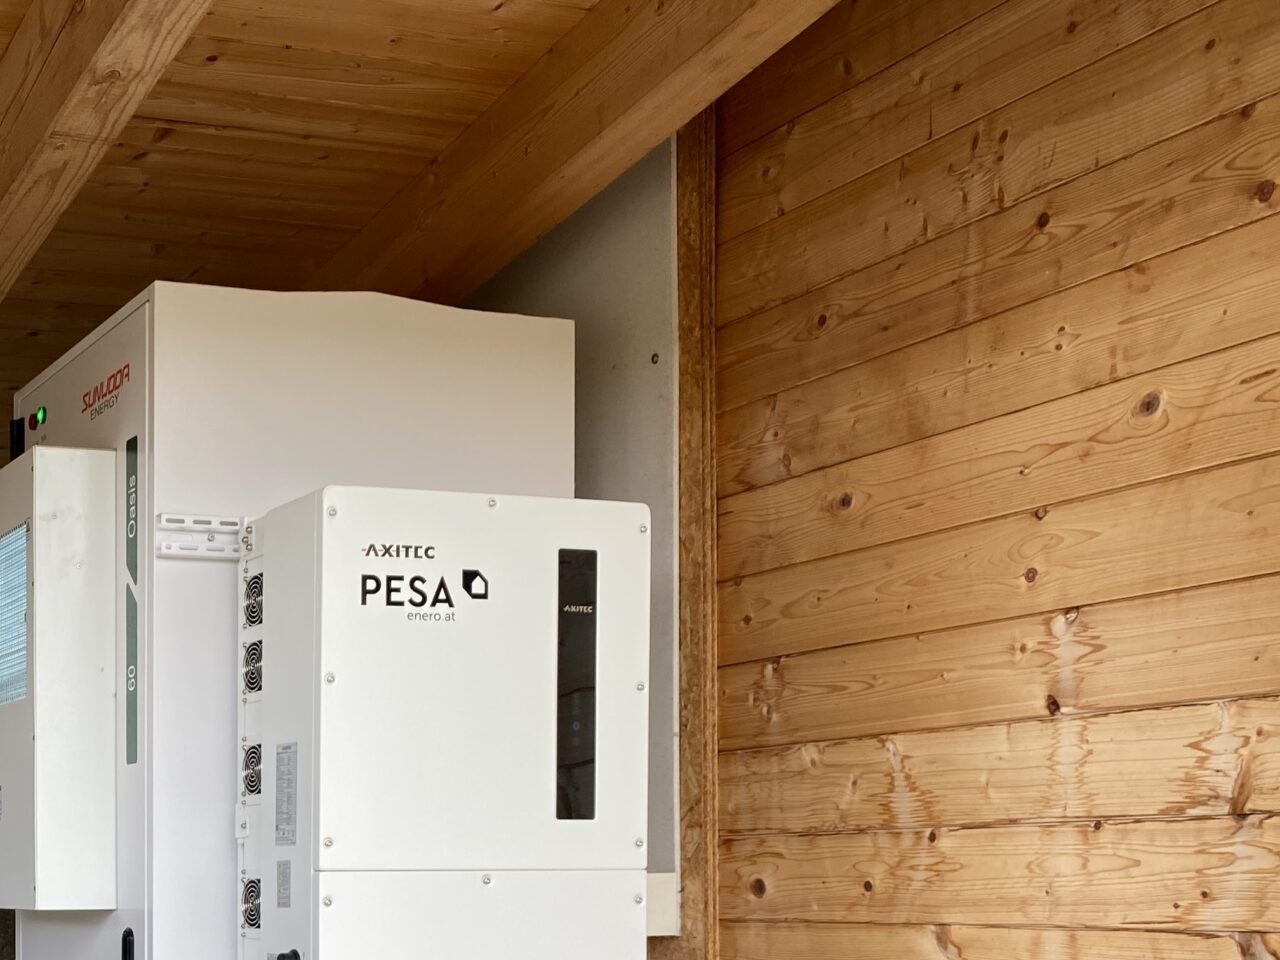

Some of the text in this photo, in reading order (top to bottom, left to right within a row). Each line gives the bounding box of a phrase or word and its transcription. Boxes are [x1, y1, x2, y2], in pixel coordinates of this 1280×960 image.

[90, 392, 120, 421] ENERGY
[127, 474, 137, 538] Oasis
[361, 543, 436, 560] AXITEC
[360, 573, 456, 609] PESA
[406, 611, 457, 622] enero.at
[562, 604, 594, 614] AXITEC
[127, 664, 137, 691] 60
